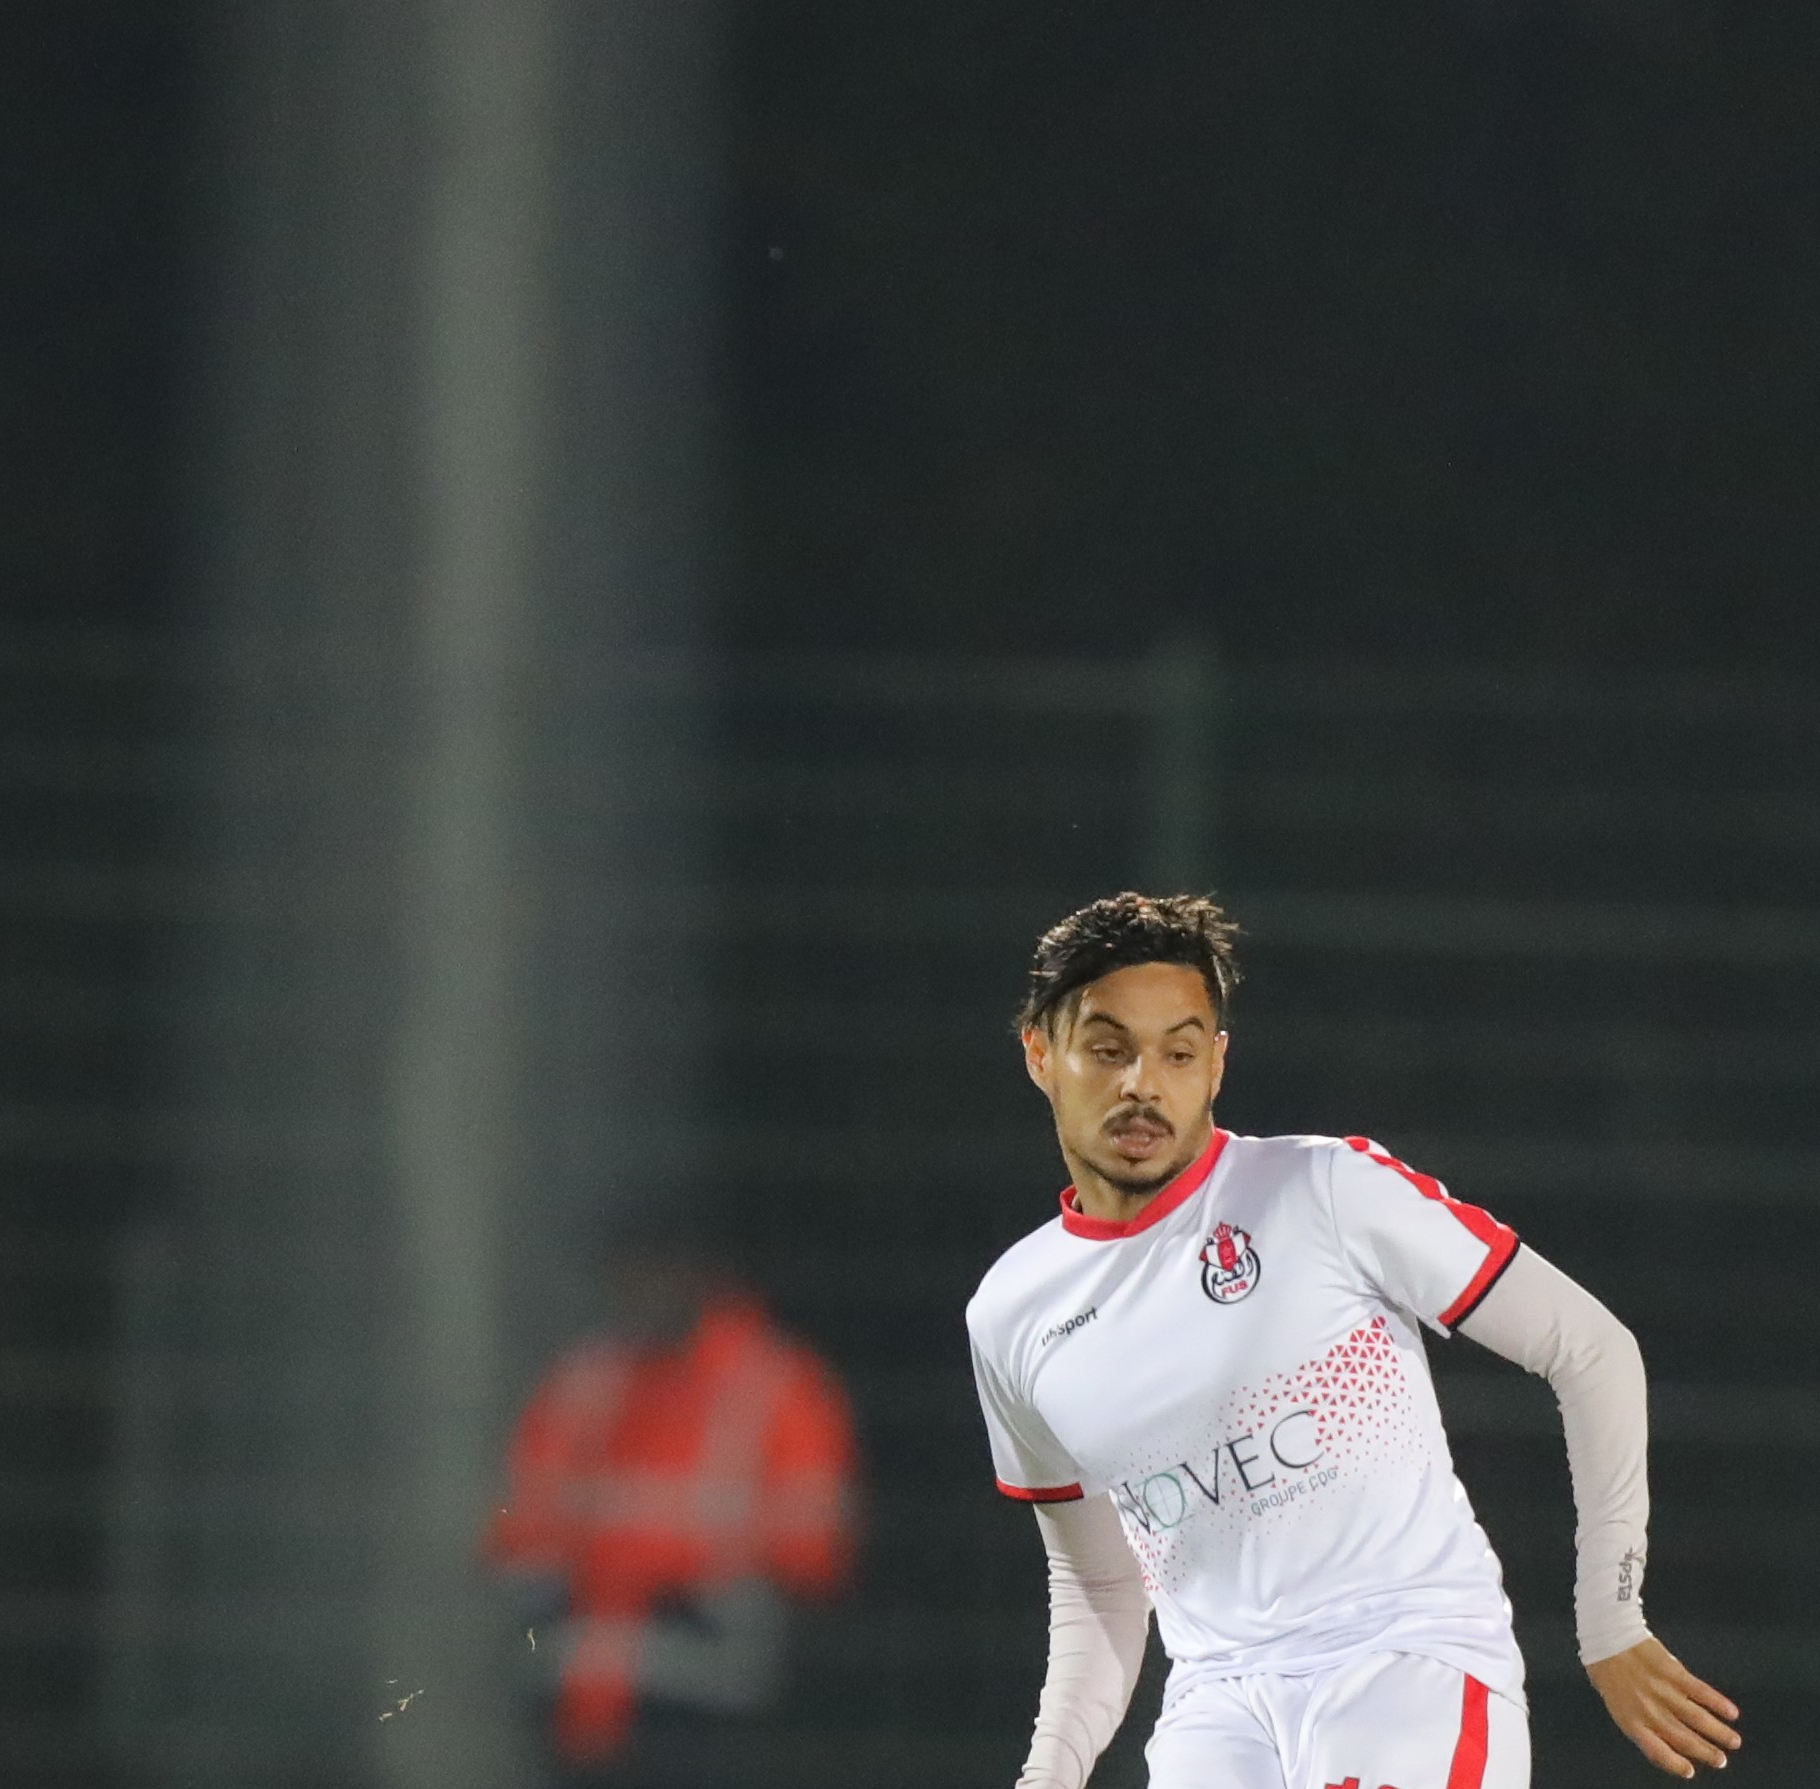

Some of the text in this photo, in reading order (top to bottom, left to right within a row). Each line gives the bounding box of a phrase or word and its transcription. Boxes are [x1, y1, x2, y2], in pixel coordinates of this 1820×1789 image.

[1222, 1280, 1248, 1298] FUS
[1250, 1467, 1338, 1516] GROUPE CDG
